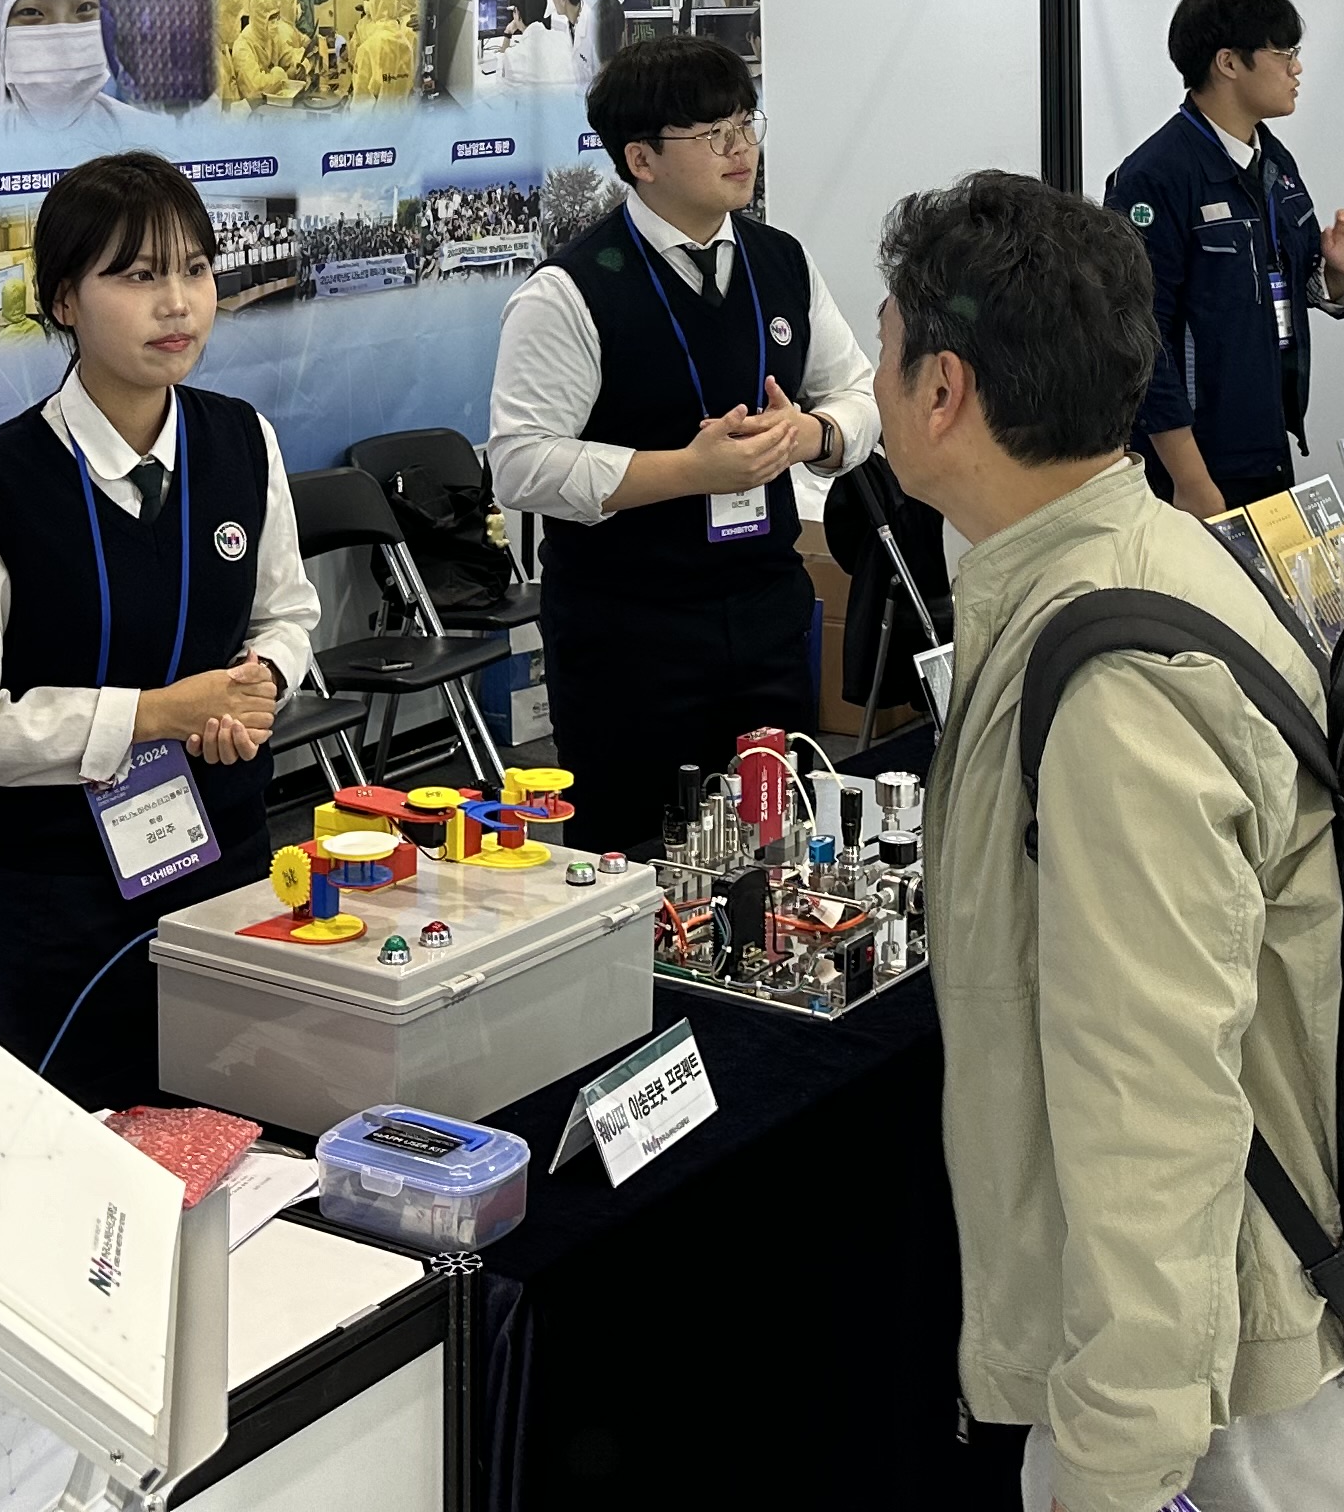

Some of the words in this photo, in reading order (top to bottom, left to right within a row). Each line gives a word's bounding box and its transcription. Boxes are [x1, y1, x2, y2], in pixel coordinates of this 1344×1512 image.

[136, 744, 169, 767] 2024
[140, 852, 200, 887] EXHIBITOR
[628, 1076, 668, 1121] 이송로봇
[664, 1051, 703, 1095] 프로젝트
